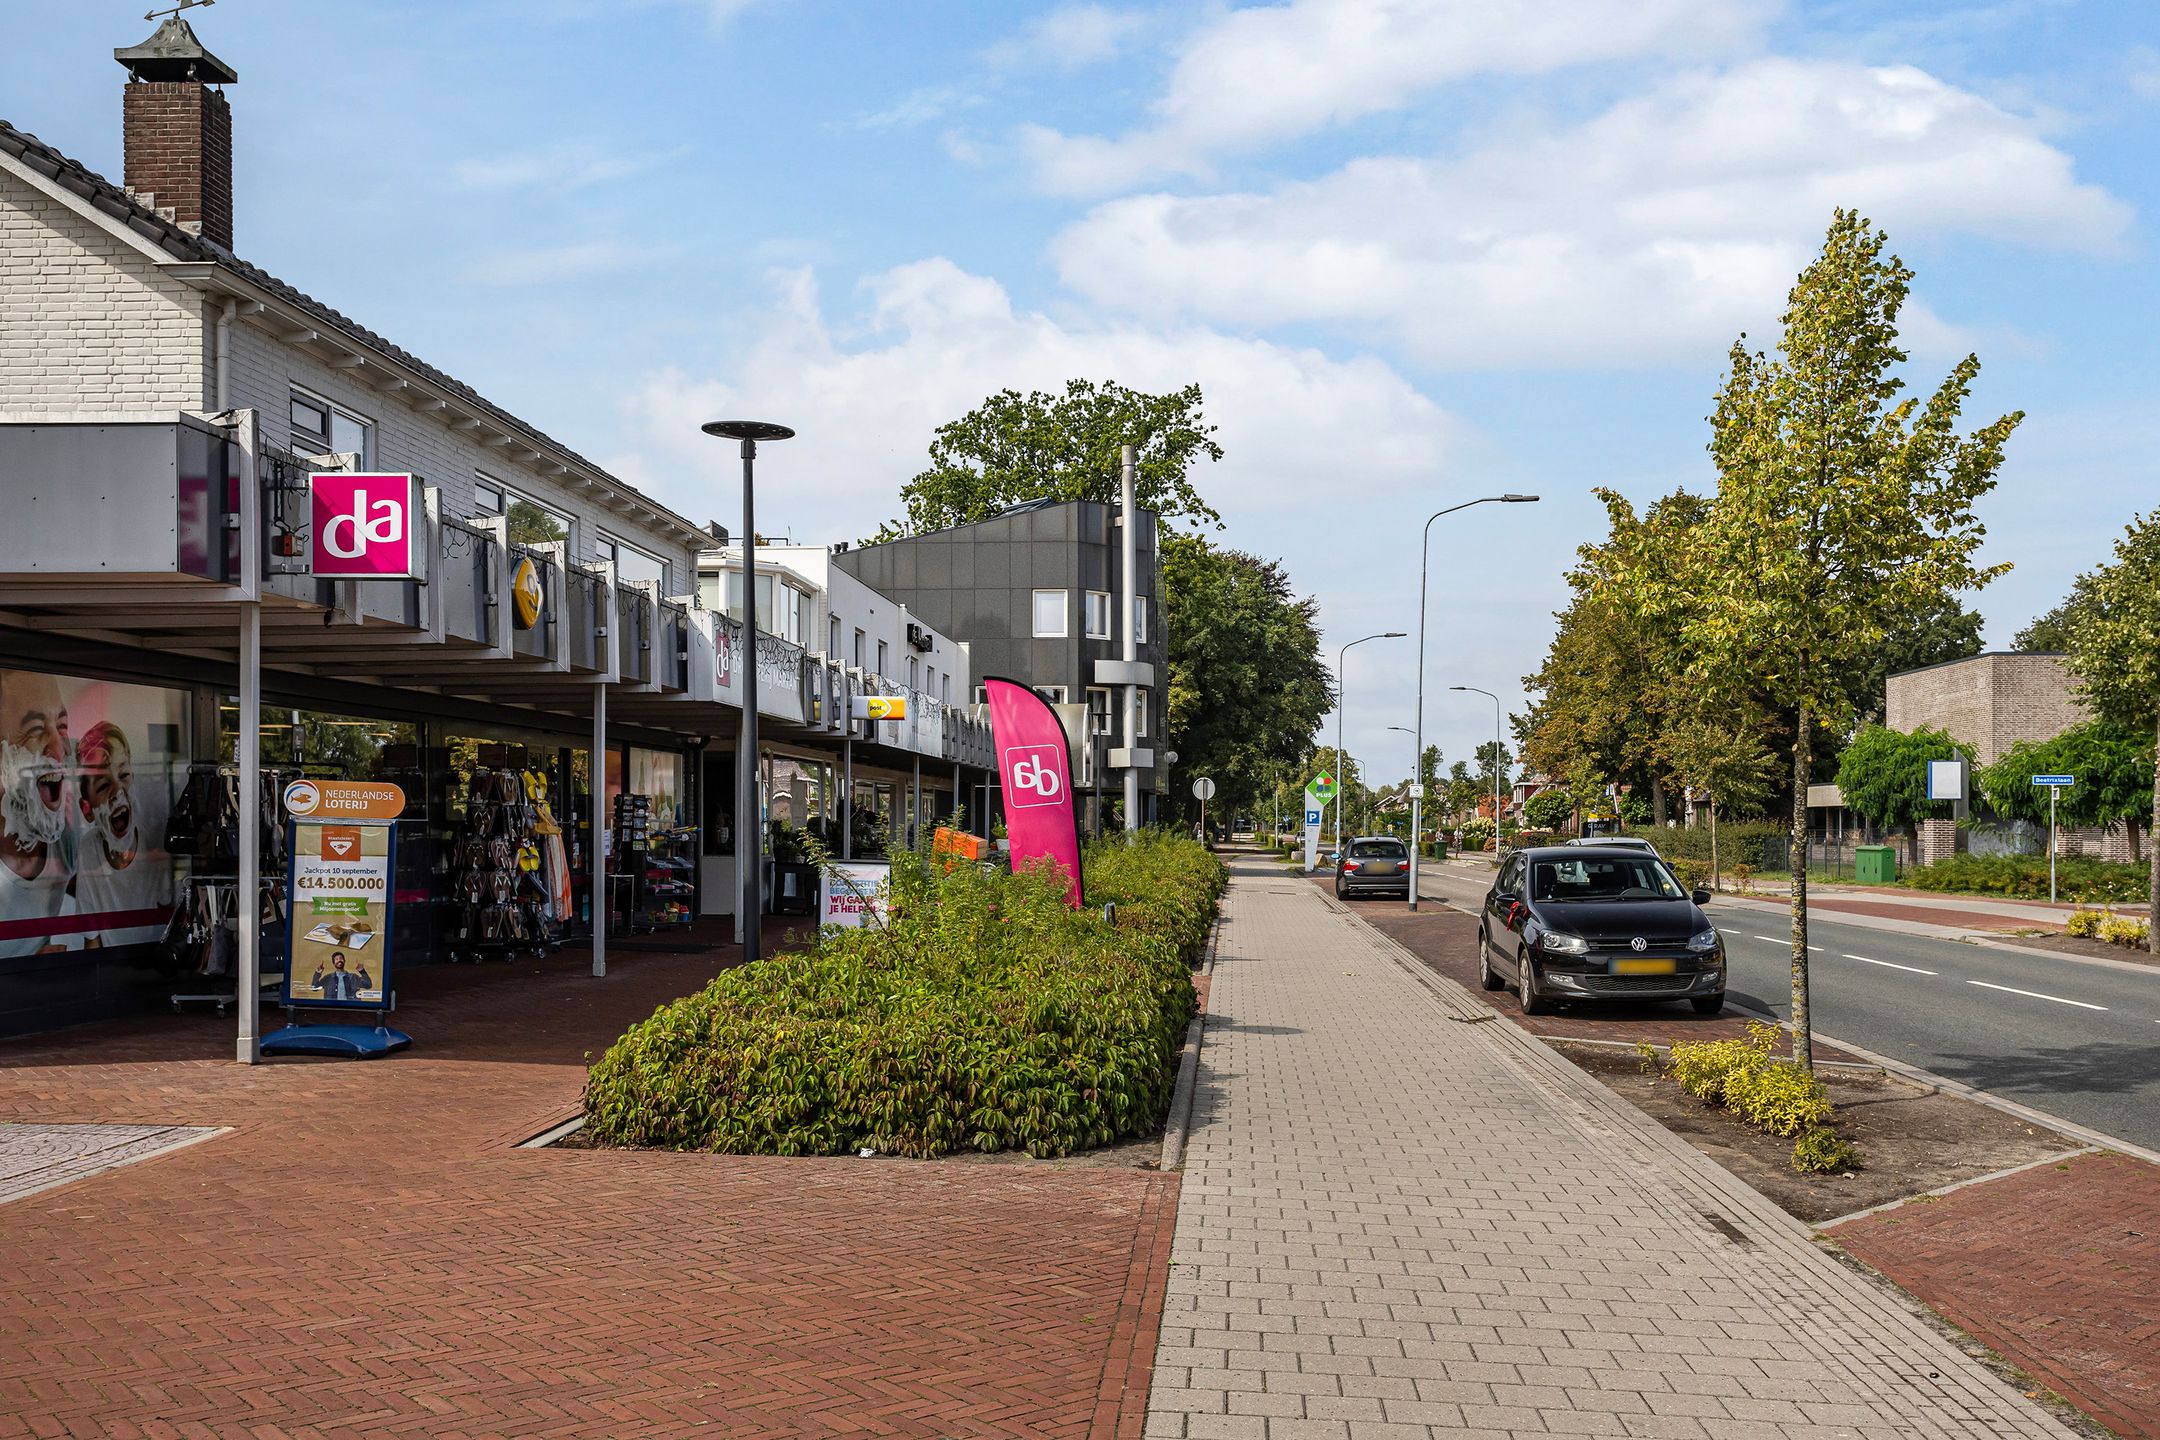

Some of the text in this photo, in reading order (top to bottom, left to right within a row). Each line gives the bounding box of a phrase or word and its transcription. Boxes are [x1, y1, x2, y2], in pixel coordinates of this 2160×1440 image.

[323, 490, 402, 558] da
[716, 640, 729, 678] da
[325, 789, 394, 801] NEDERLANDSE
[325, 800, 368, 810] LOTERIJ
[304, 867, 331, 875] Jackpot
[297, 877, 385, 889] €14.500.000
[829, 905, 839, 914] JE
